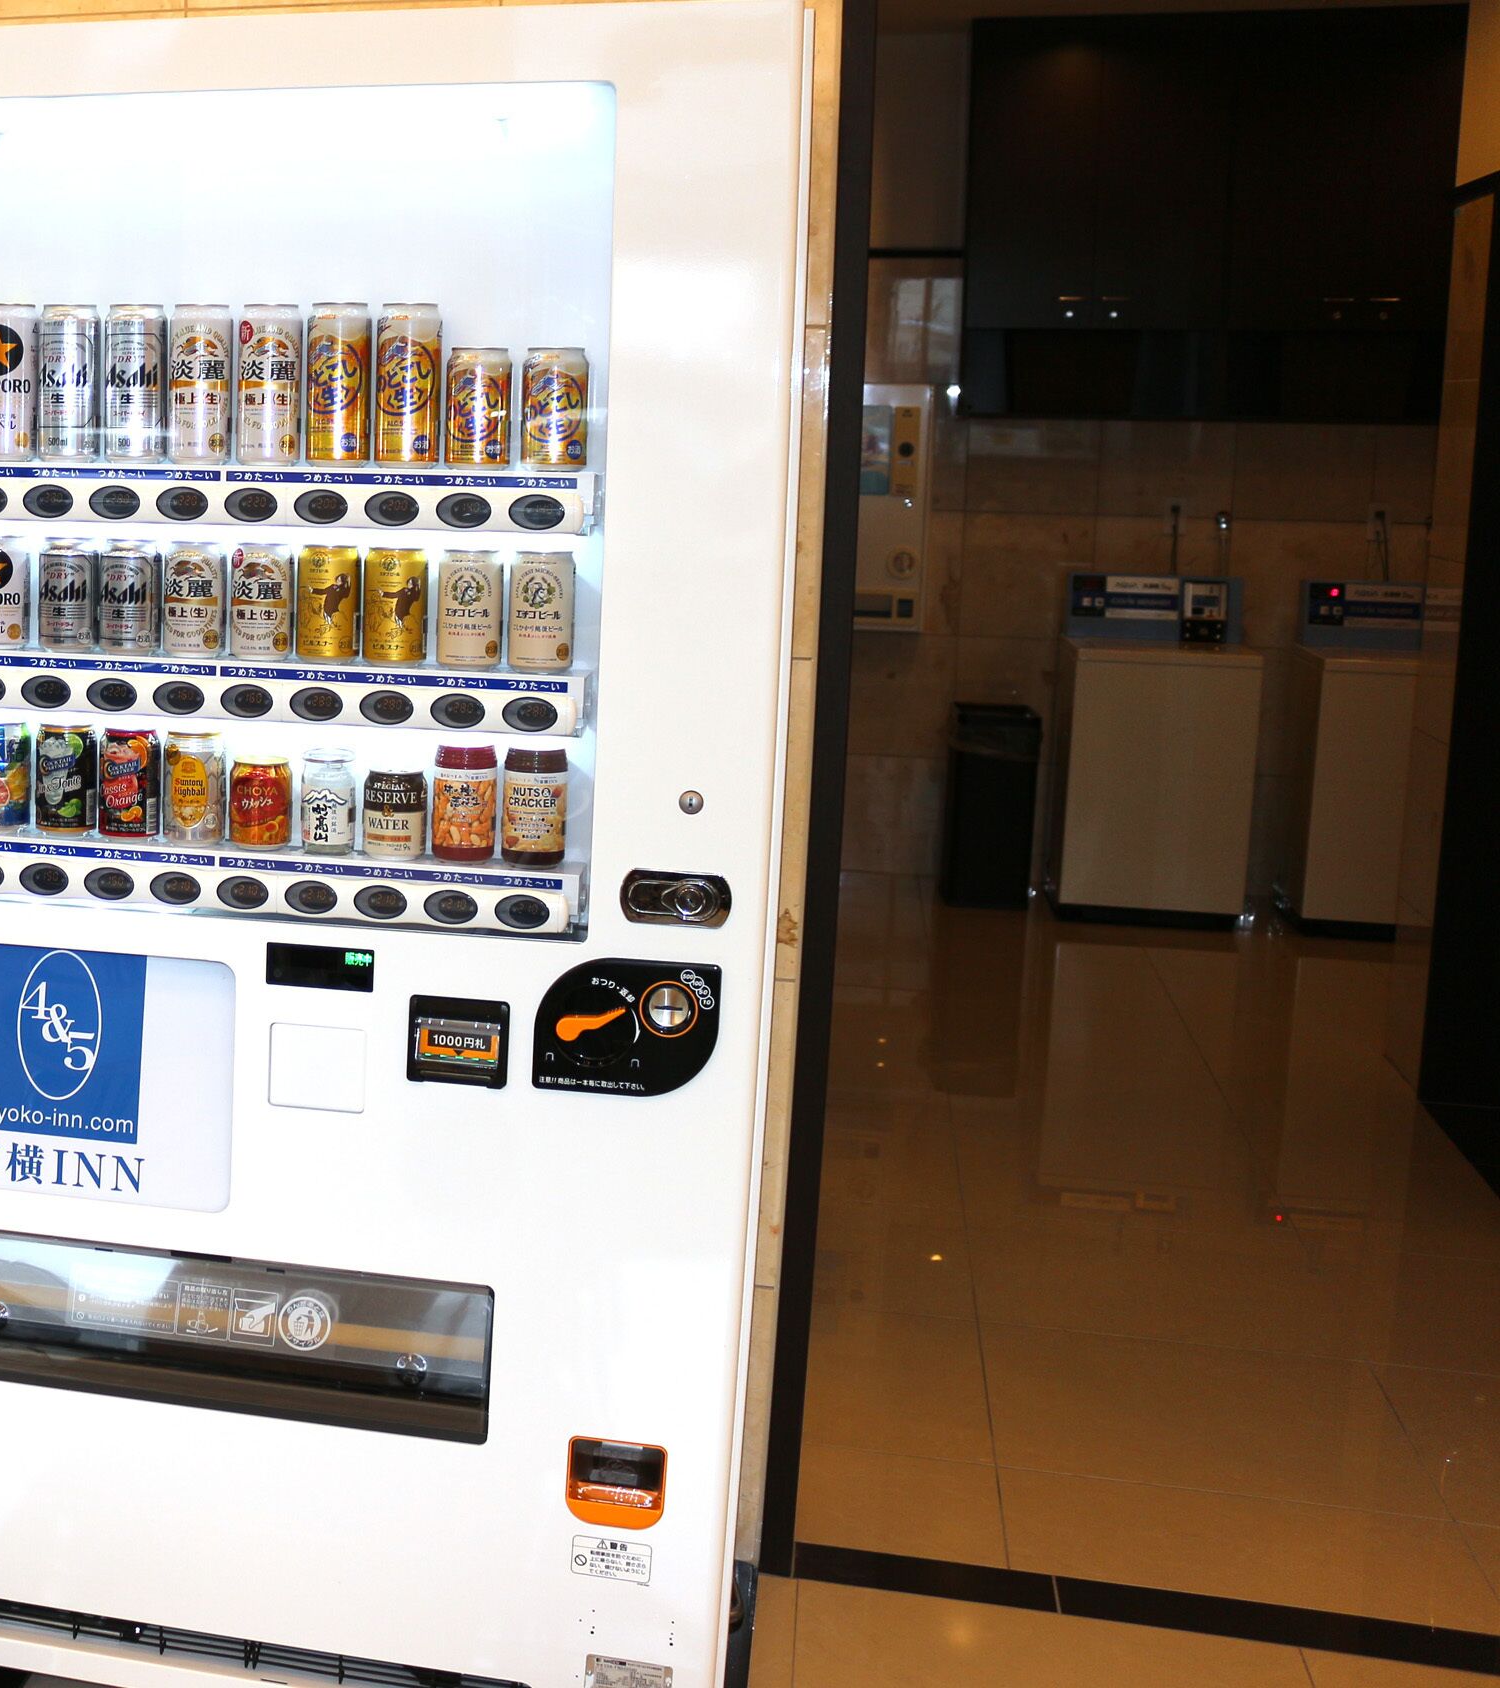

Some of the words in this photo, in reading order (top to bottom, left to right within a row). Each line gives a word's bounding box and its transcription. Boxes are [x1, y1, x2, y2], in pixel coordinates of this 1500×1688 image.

[241, 324, 252, 341] 新
[105, 362, 158, 389] Asahi
[171, 360, 225, 381] 淡麗
[241, 360, 296, 381] 淡麗
[50, 393, 66, 404] 生
[39, 579, 87, 602] Asahi
[100, 581, 147, 605] Asahi
[165, 579, 213, 598] 淡麗
[233, 580, 283, 600] 淡麗
[52, 606, 66, 617] 生
[112, 608, 126, 619] 生
[445, 607, 490, 618] エチゴビール
[516, 609, 561, 620] エチゴビール
[107, 761, 137, 773] COCKTAIL
[174, 778, 203, 788] Suntory
[372, 781, 406, 790] SPECIAL
[174, 787, 206, 797] Highball
[236, 785, 278, 796] CHOYA
[365, 789, 417, 804] RESERVE
[512, 787, 540, 797] NUTS
[106, 792, 143, 808] Orange
[241, 796, 273, 809] ウメッシュ
[509, 797, 557, 808] CRACKER
[381, 804, 395, 818] &
[312, 803, 330, 843] 妙高山
[368, 817, 410, 831] WATER
[344, 951, 373, 968] 販売中
[591, 977, 636, 1003] おつり・返却
[21, 980, 95, 1071] 4&5
[432, 1033, 486, 1050] 1000円札
[286, 1335, 321, 1347] リサイクル
[610, 1541, 628, 1552] 警告
